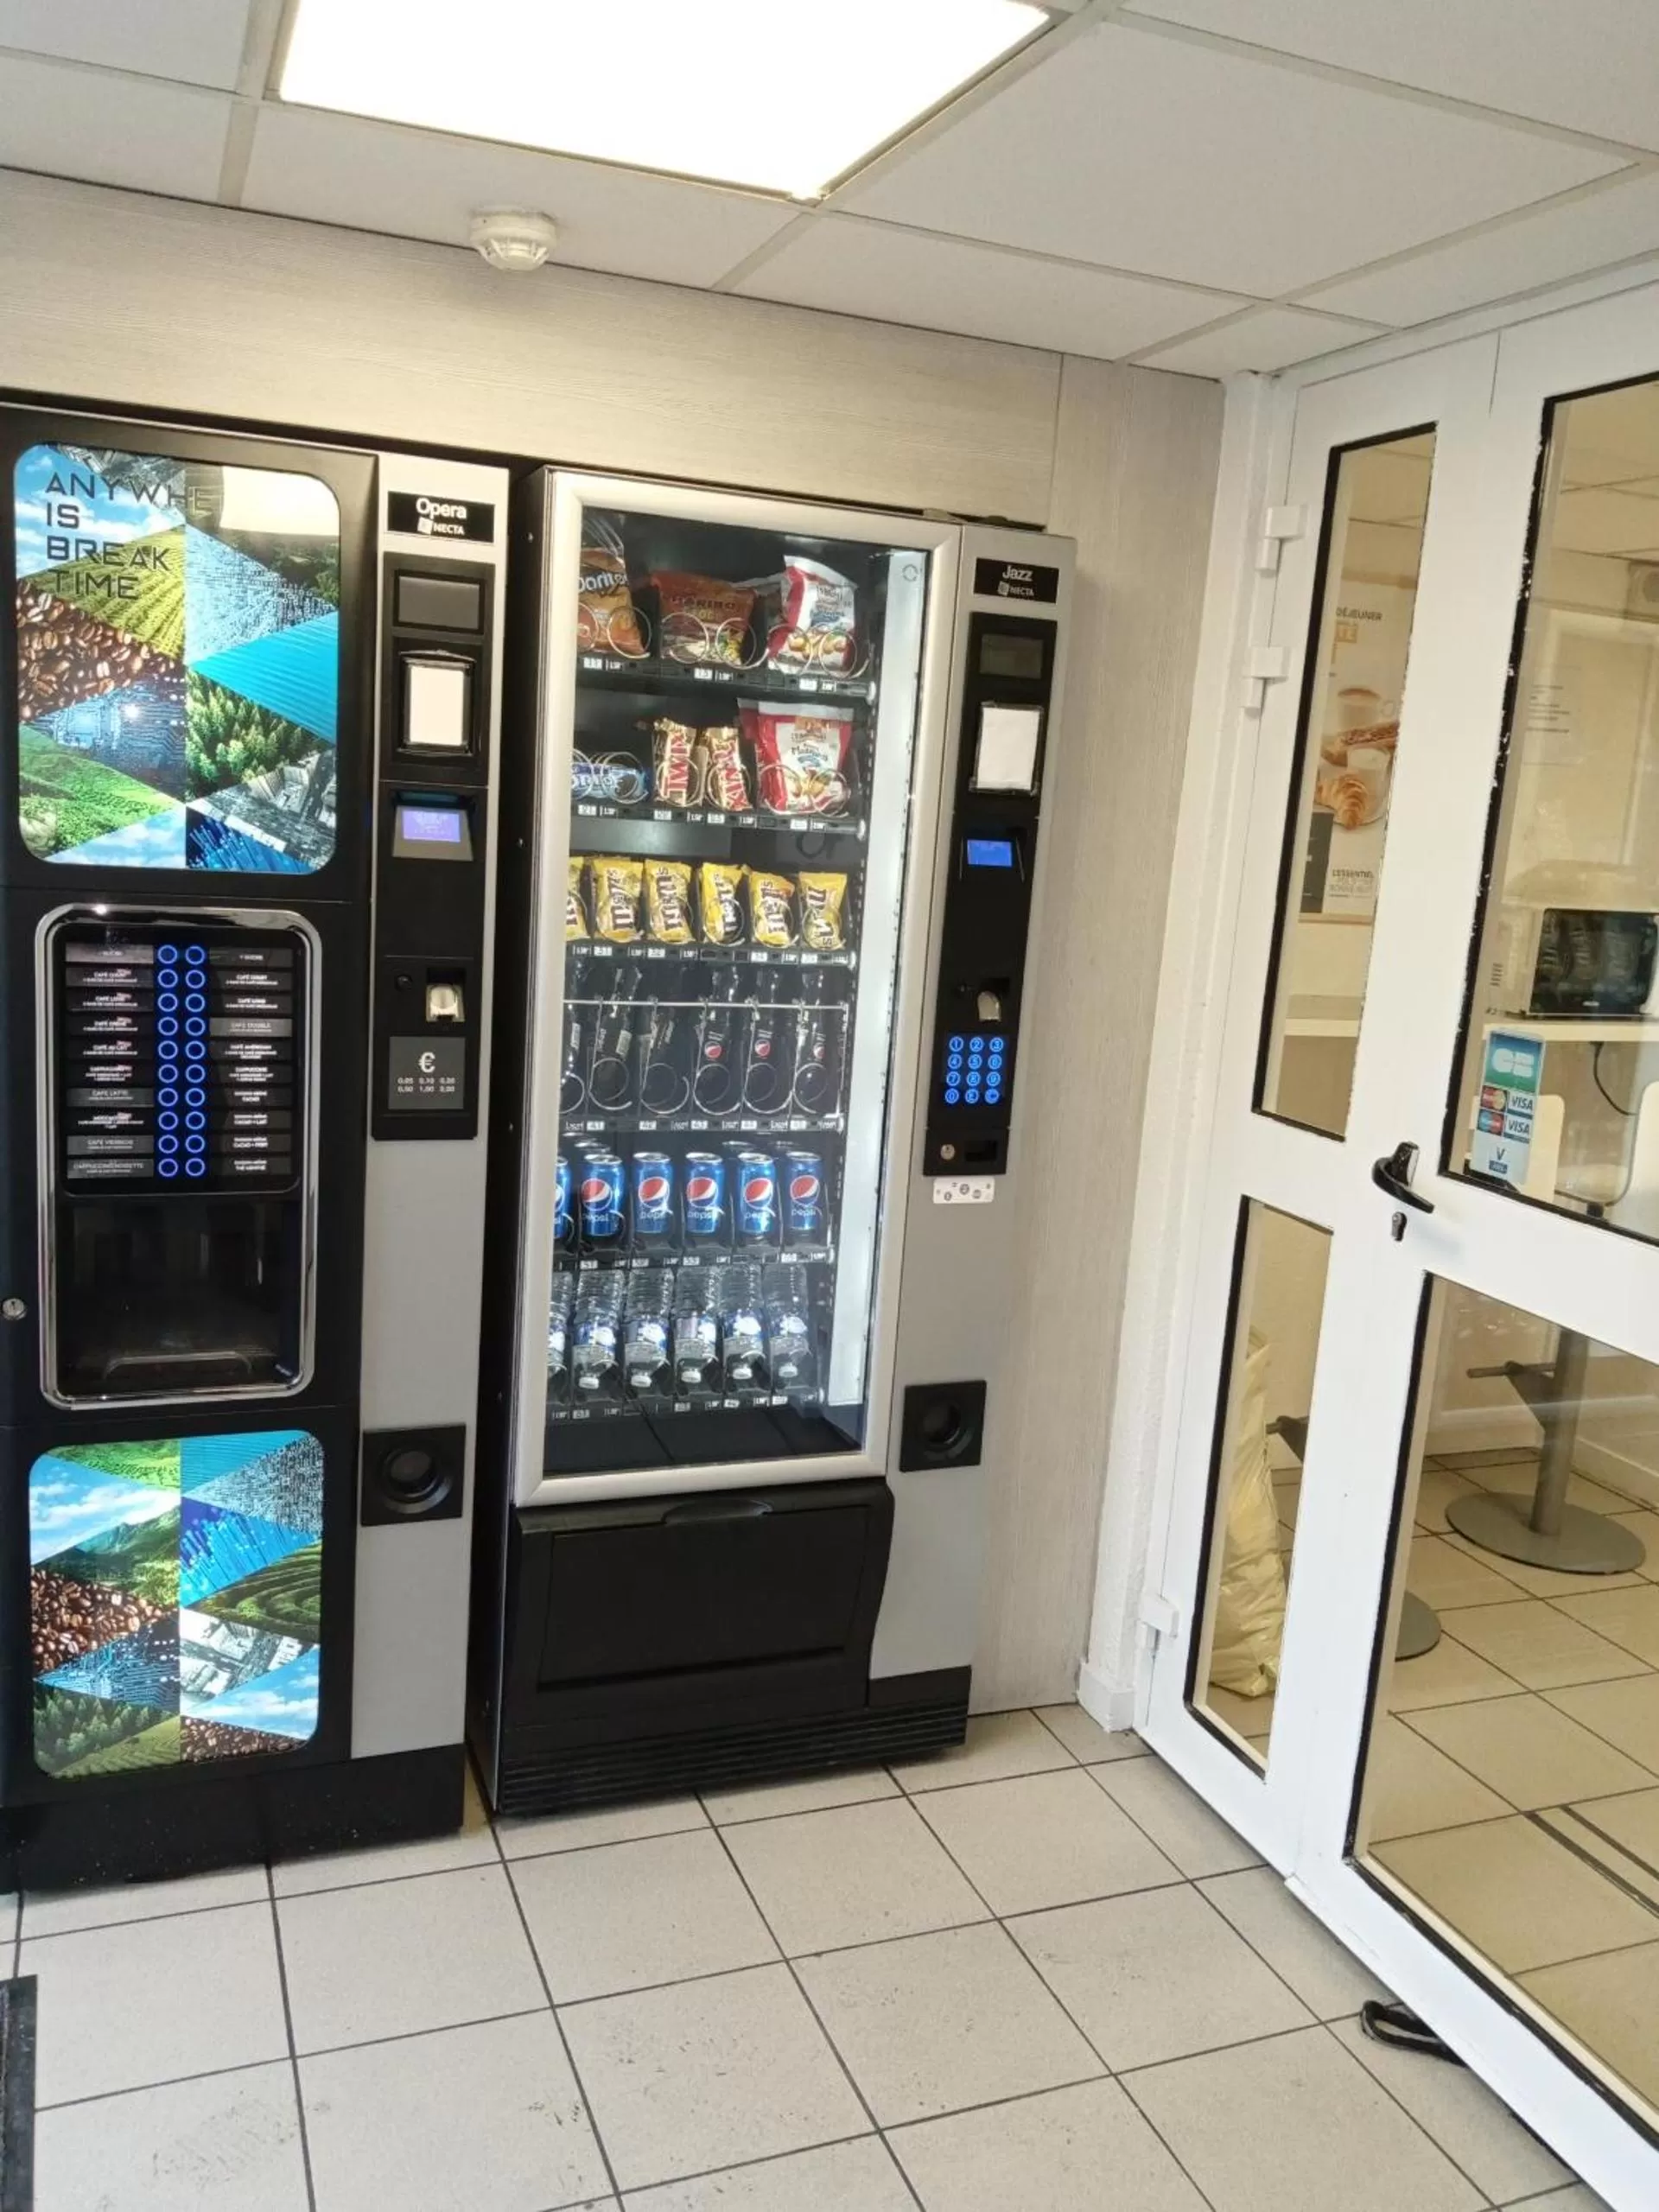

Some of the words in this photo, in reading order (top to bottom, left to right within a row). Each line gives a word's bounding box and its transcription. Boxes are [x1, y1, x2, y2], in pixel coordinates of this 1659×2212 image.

[46, 472, 213, 516] ANYWHE
[47, 502, 79, 529] IS
[416, 497, 467, 519] Opera
[433, 523, 465, 535] NECTA
[47, 535, 171, 571] BREAK
[48, 569, 139, 601] TIME
[1002, 565, 1033, 582] Jazz
[661, 733, 689, 799] TWIX
[1512, 1095, 1534, 1110] VISA
[1508, 1119, 1530, 1135] VISA
